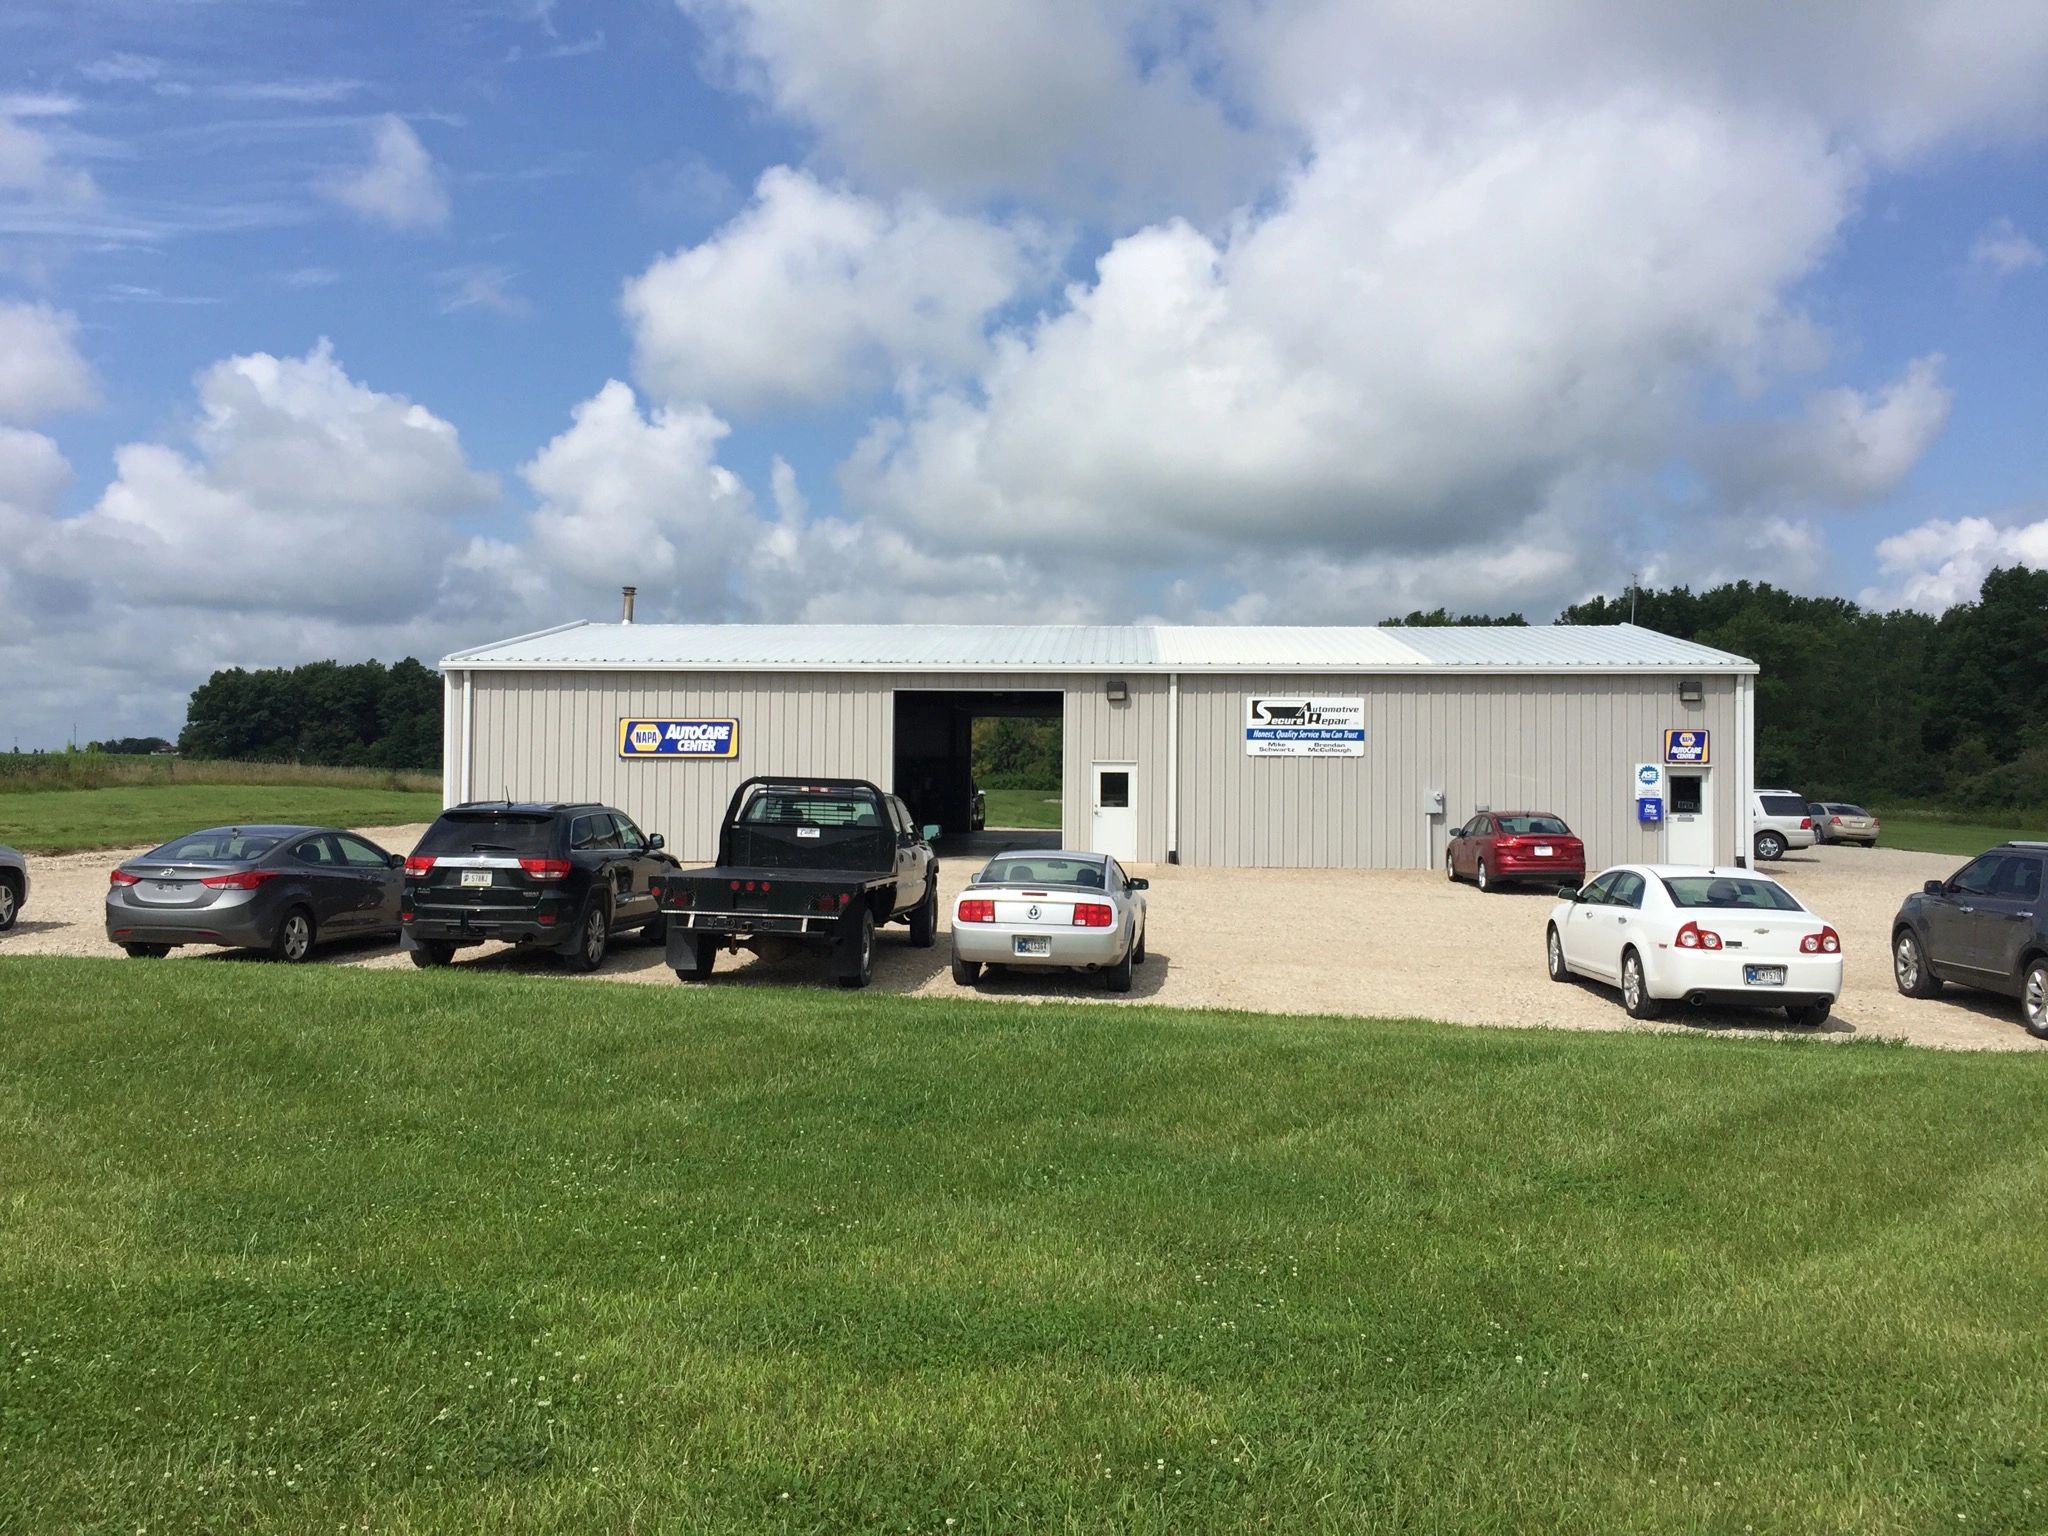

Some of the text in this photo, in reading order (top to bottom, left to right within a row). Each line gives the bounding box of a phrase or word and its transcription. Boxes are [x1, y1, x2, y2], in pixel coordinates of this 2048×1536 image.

[1252, 700, 1350, 726] Secure Repair
[1296, 701, 1359, 716] Automotive
[636, 731, 657, 744] NAPA
[1253, 730, 1359, 740] Honest, Quality Service You Can Trust
[677, 740, 716, 752] CENTER
